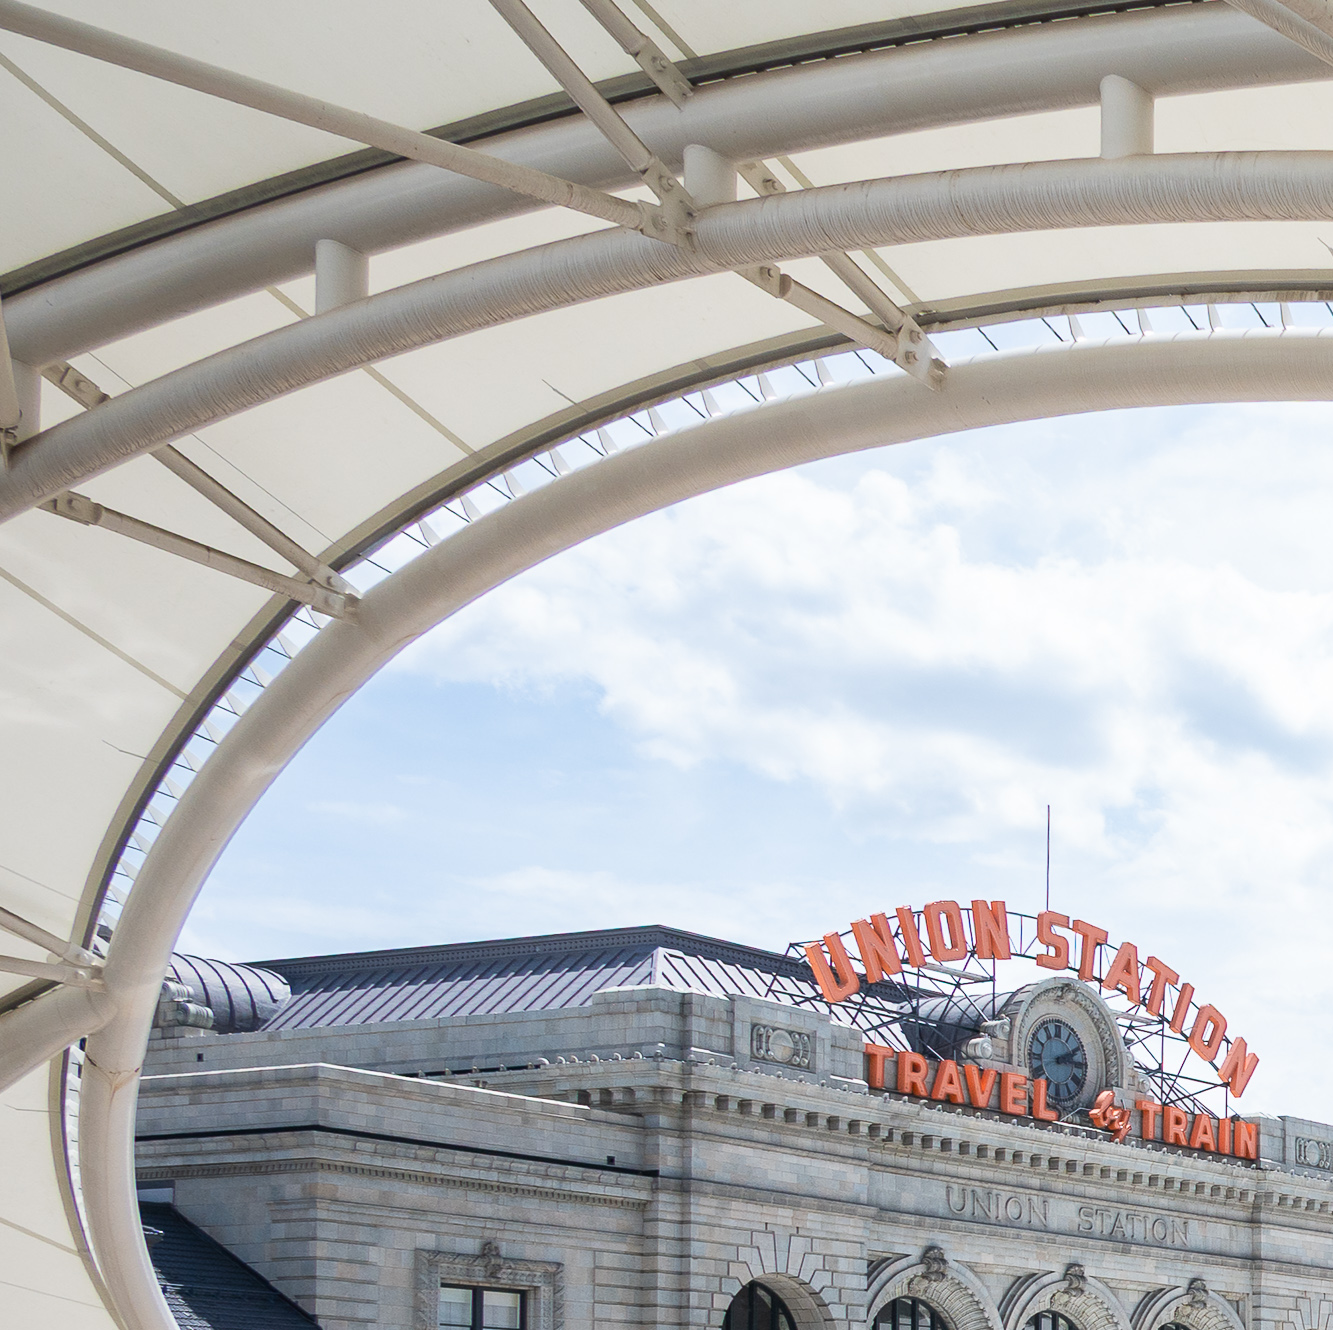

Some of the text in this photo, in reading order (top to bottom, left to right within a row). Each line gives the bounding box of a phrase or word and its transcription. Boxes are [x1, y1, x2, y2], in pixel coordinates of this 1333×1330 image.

[805, 899, 1260, 1099] UNION STATION
[865, 1043, 1259, 1160] TRAVEL & TRAIN
[946, 1185, 1189, 1247] UNION STATION
